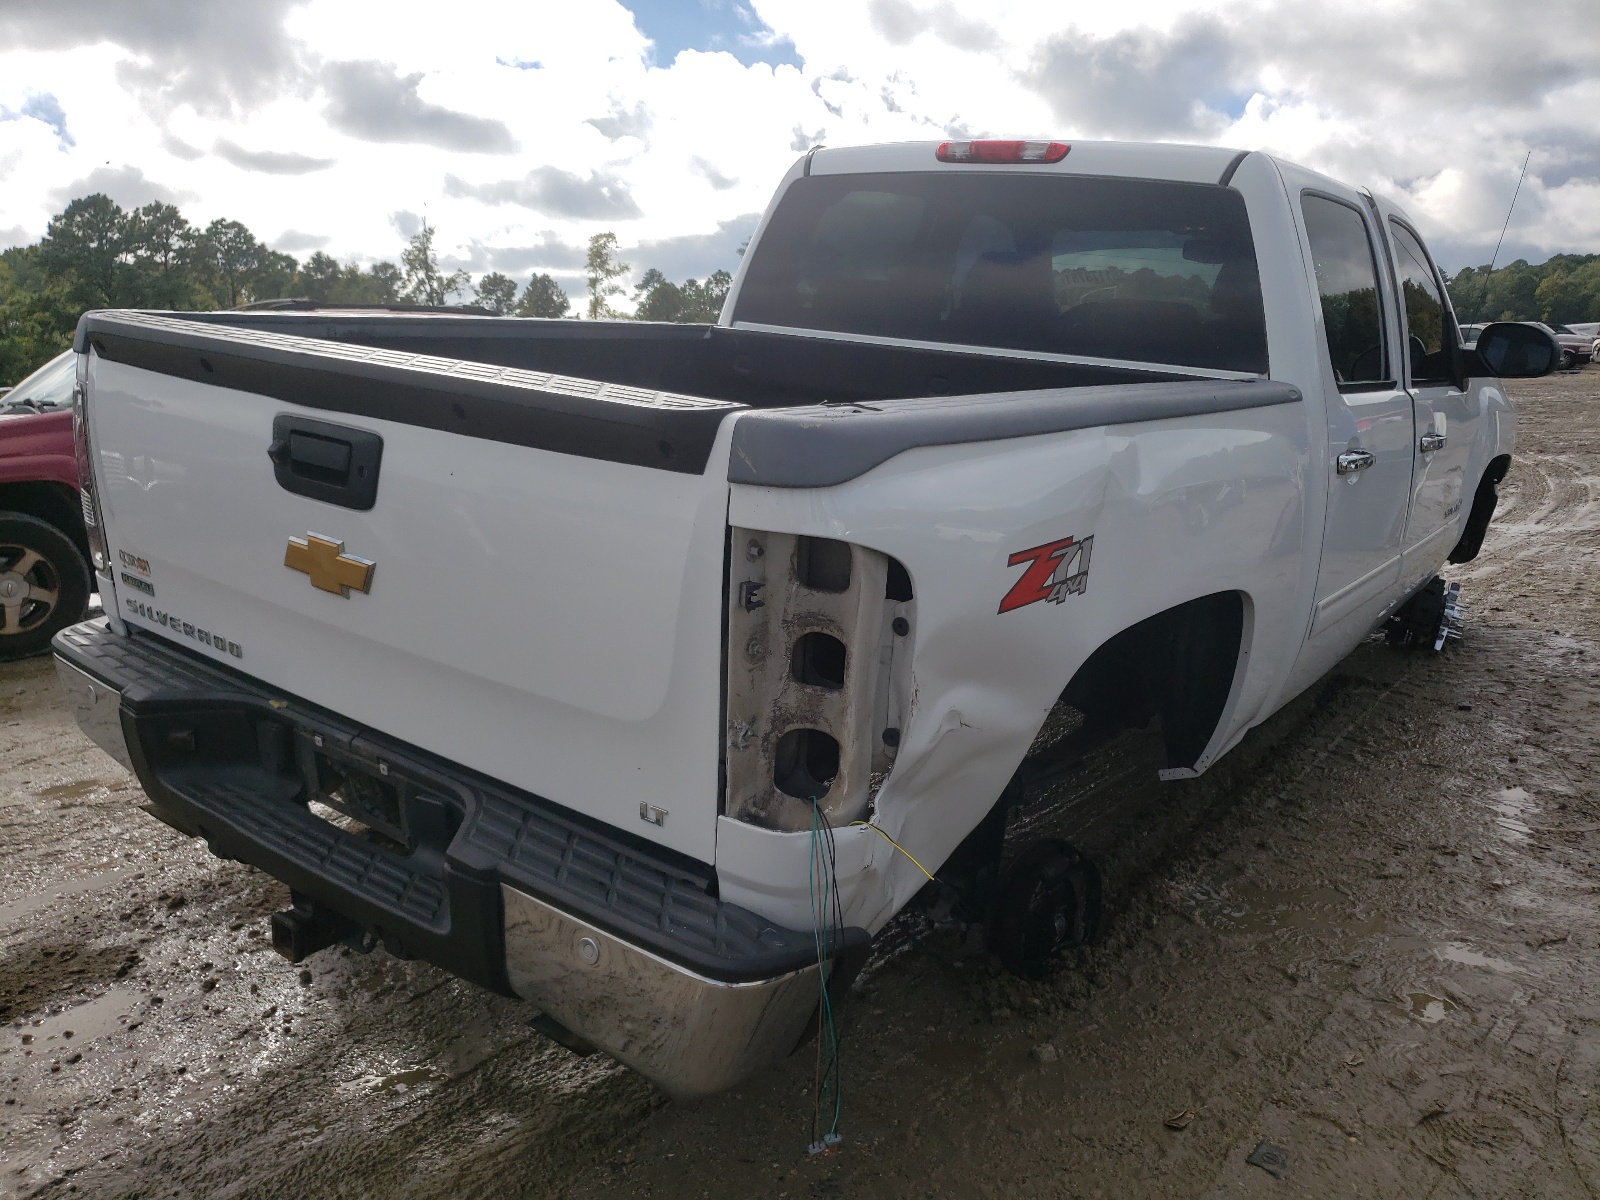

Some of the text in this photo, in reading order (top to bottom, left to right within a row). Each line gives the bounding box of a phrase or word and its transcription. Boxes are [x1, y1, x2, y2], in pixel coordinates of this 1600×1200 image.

[997, 534, 1095, 615] Z71
[126, 598, 243, 659] SILVERADO
[639, 800, 669, 828] LT
